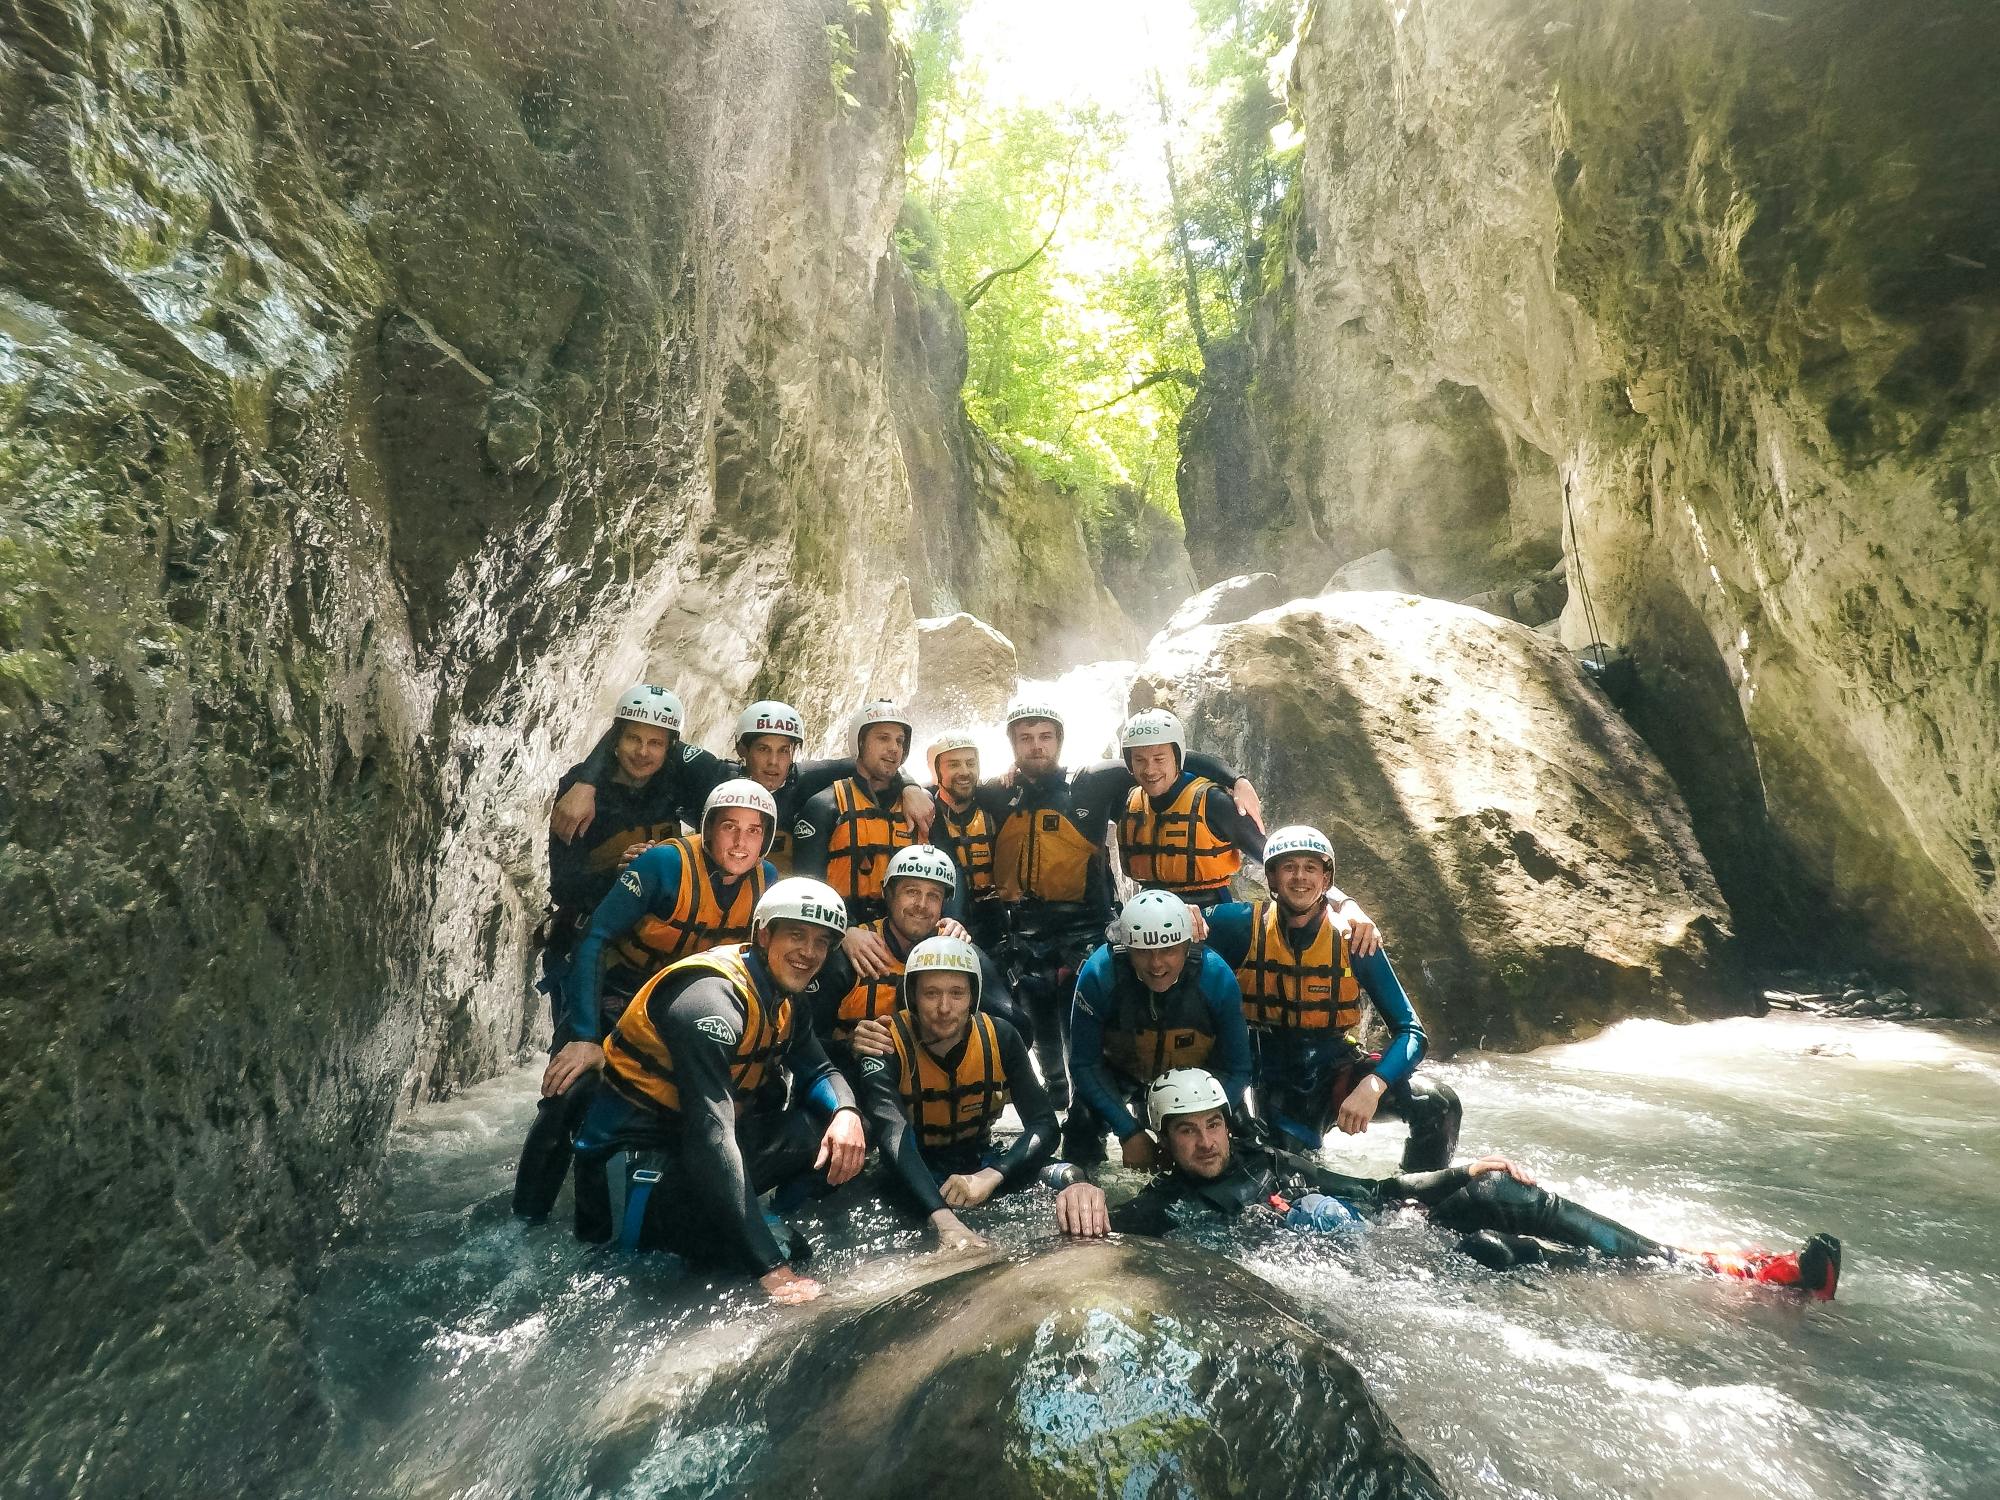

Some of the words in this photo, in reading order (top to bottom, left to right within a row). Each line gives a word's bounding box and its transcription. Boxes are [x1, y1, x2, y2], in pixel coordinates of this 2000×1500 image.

[620, 706, 648, 719] Darth
[653, 711, 680, 727] Vader
[756, 718, 799, 734] BLADE
[715, 794, 745, 804] Iron
[749, 794, 774, 811] Man
[1269, 838, 1327, 855] Hercules
[897, 863, 931, 876] Moby
[935, 866, 954, 883] Dick
[801, 903, 845, 930] Elvis
[1143, 930, 1182, 946] Wow
